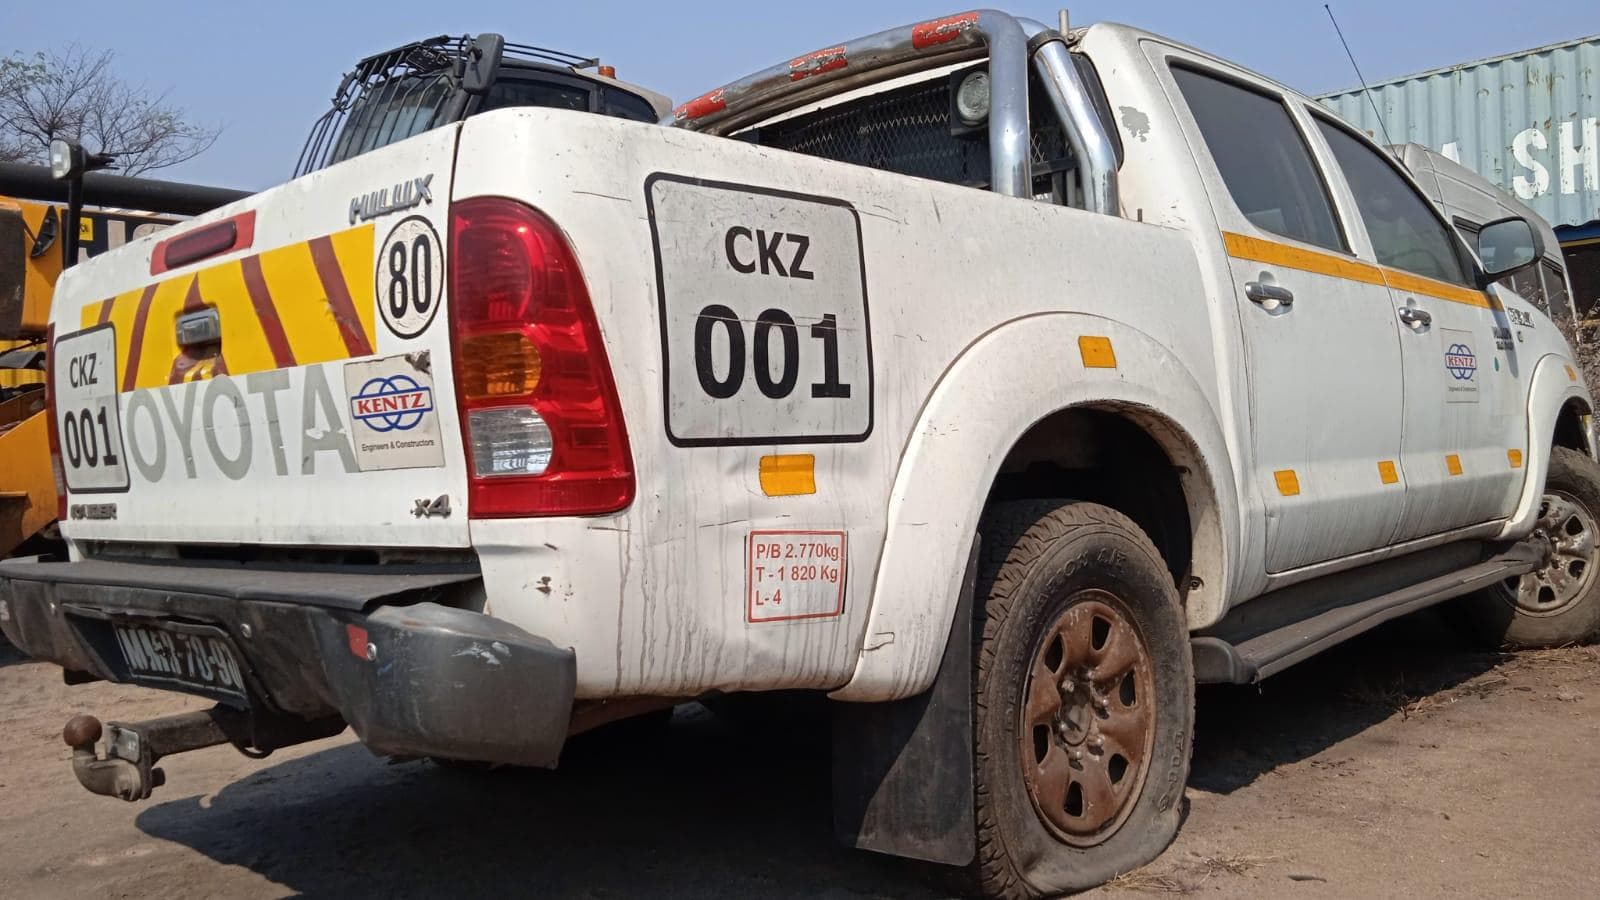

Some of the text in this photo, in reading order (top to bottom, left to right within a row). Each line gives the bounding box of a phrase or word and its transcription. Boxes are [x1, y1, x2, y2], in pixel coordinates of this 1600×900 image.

[349, 173, 434, 226] HILUX
[389, 234, 432, 319] 80
[725, 226, 814, 281] CKZ
[69, 352, 98, 389] CKZ
[694, 304, 851, 400] 001
[1448, 356, 1474, 367] KENTZ
[119, 364, 361, 483] OYOTA
[357, 392, 426, 415] KENTZ
[64, 406, 119, 469] 001
[756, 543, 839, 562] P/B 2.770kg
[791, 565, 817, 581] 820
[820, 565, 838, 583] Kg
